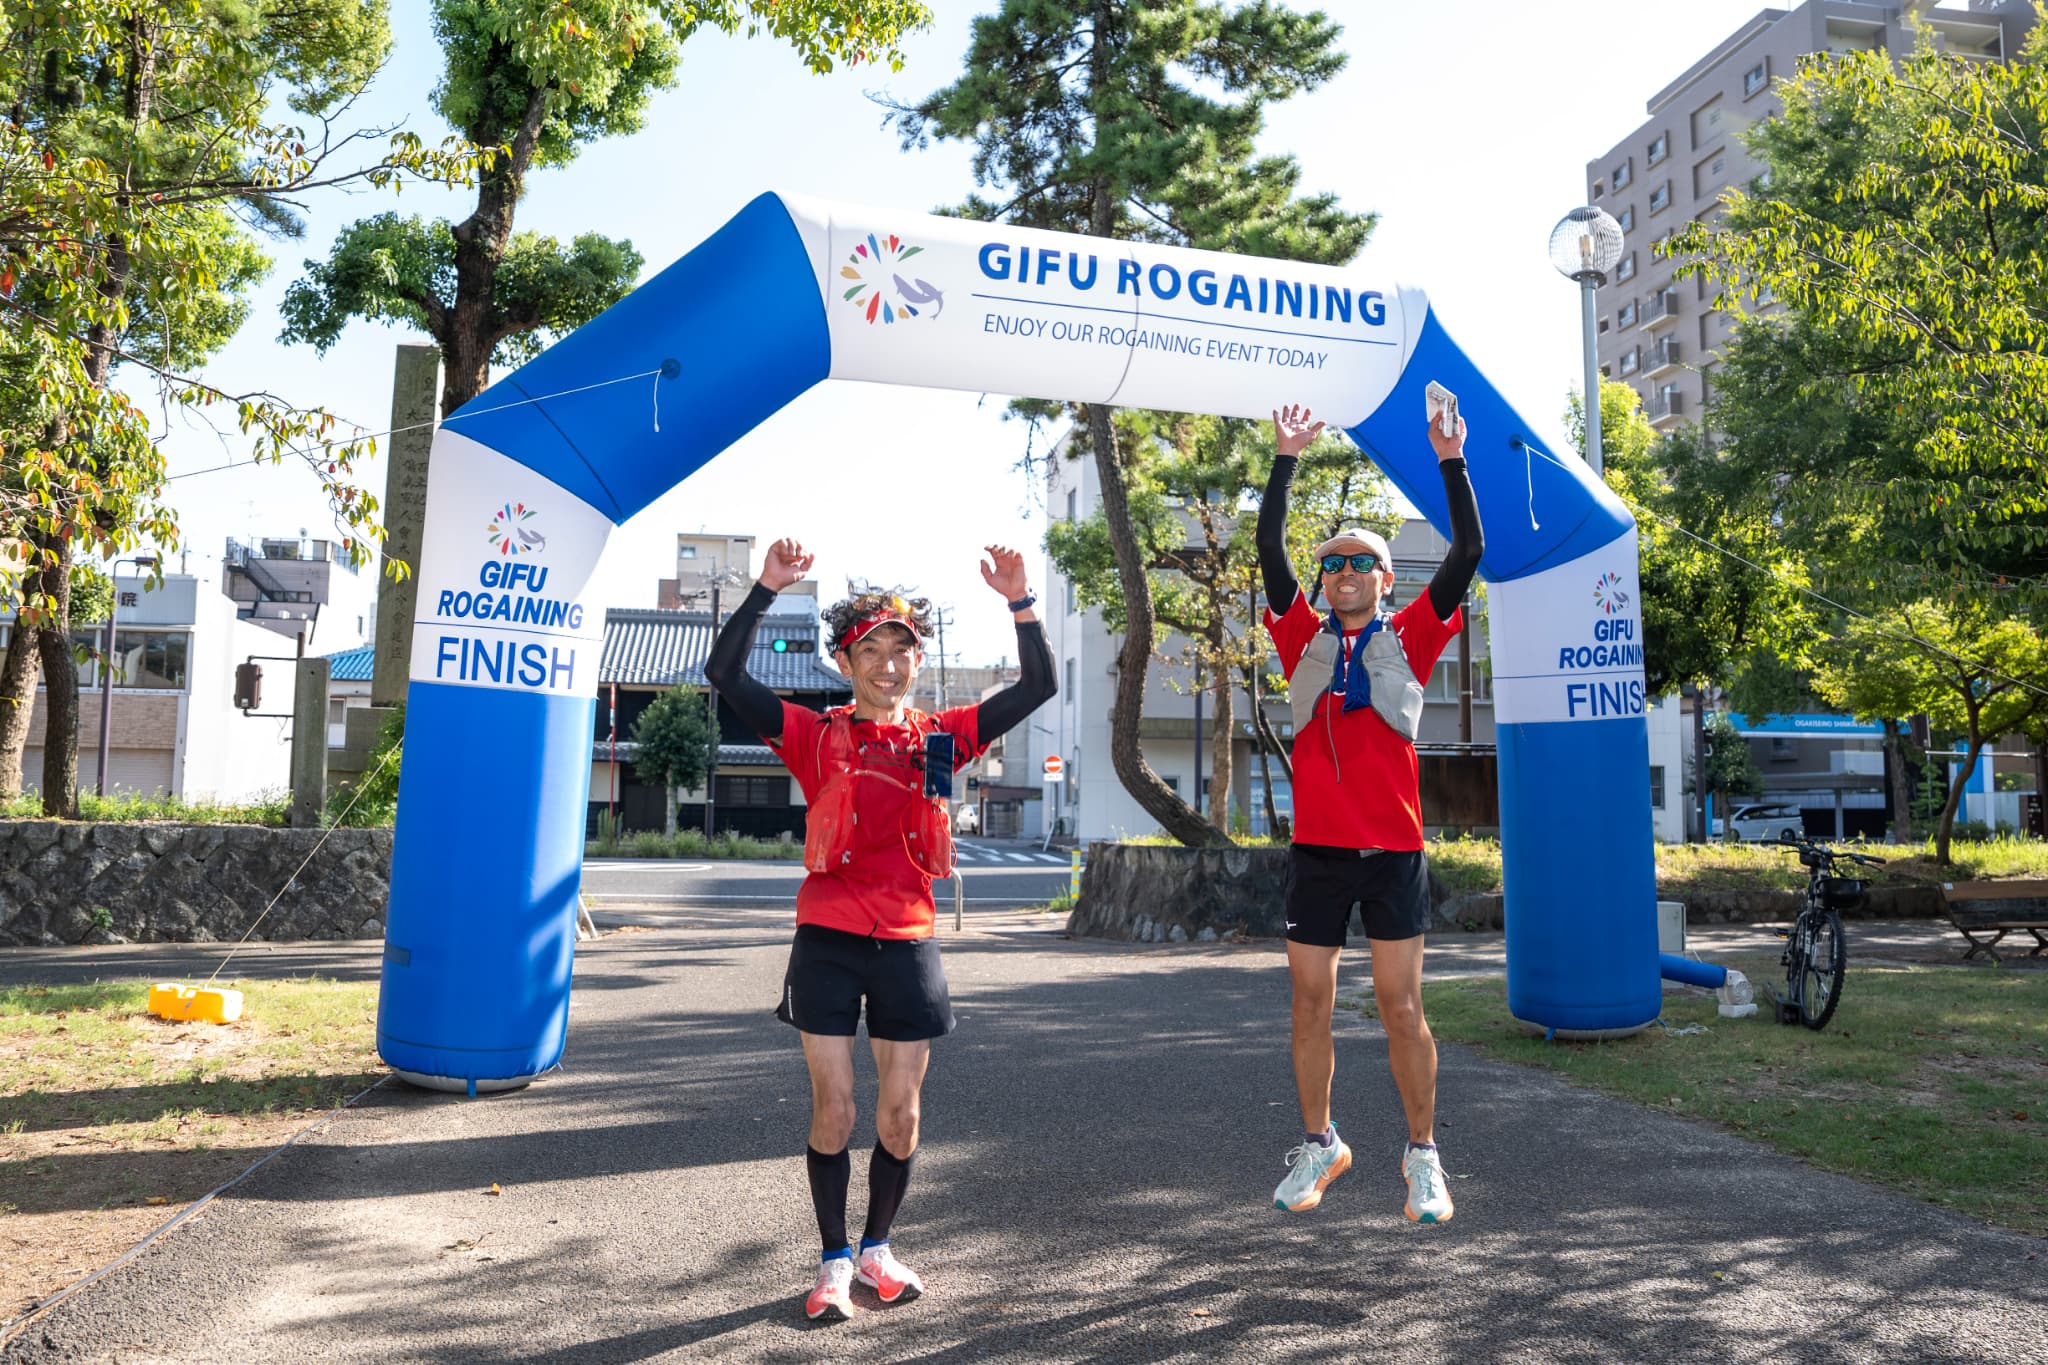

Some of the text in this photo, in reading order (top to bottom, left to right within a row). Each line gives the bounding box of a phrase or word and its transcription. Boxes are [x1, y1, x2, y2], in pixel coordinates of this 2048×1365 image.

[978, 241, 1388, 328] GIFU ROGAINING
[983, 314, 1328, 371] ENJOY OUR ROGAINING EVENT TODAY
[479, 560, 549, 593] GIFU
[437, 590, 584, 630] ROGAINING
[1594, 619, 1633, 642] GIFU
[436, 636, 576, 690] FINISH
[1559, 644, 1643, 669] ROGAININ
